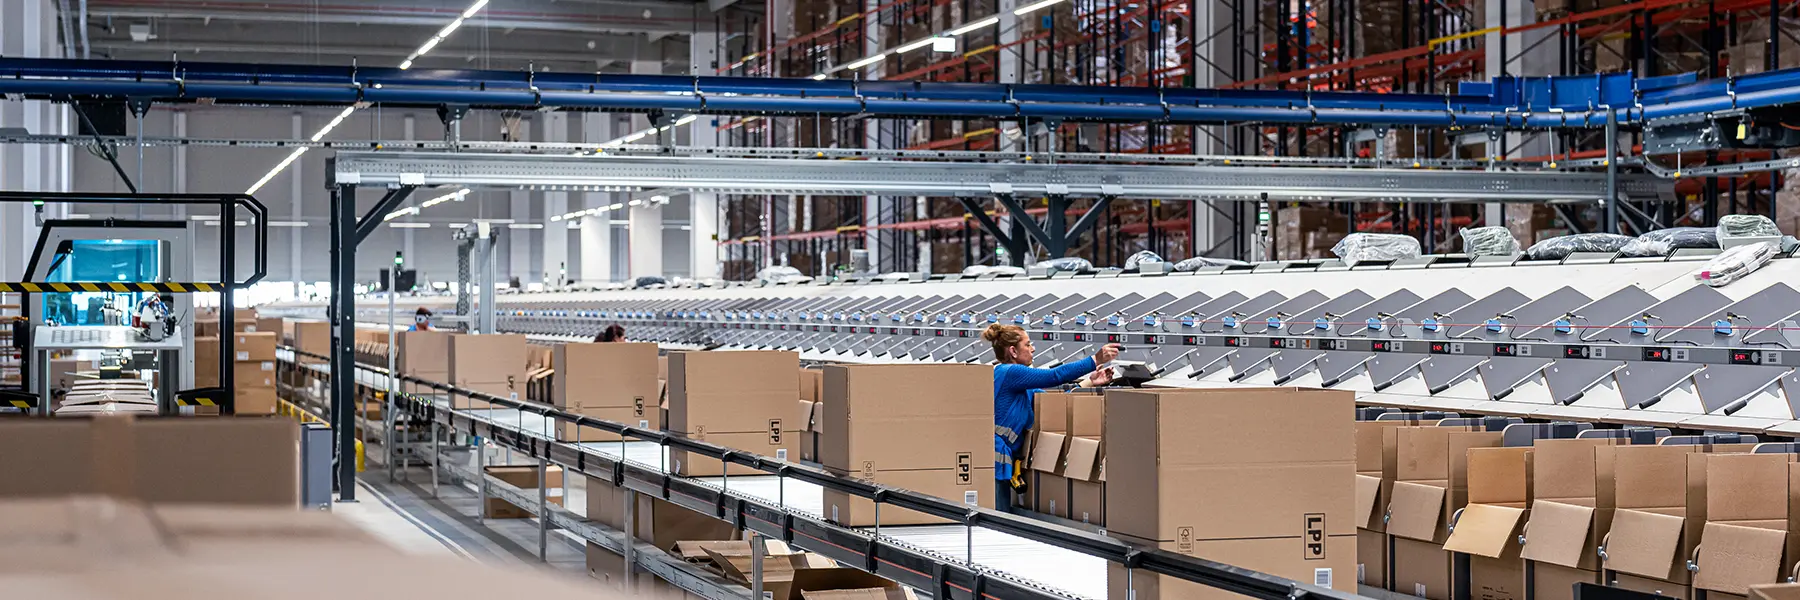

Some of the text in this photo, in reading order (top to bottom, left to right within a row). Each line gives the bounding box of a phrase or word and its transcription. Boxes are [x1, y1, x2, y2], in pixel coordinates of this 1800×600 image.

[635, 398, 643, 415] LPP
[770, 421, 780, 442] LPP
[958, 454, 969, 482] LPP
[1307, 517, 1322, 555] LPP
